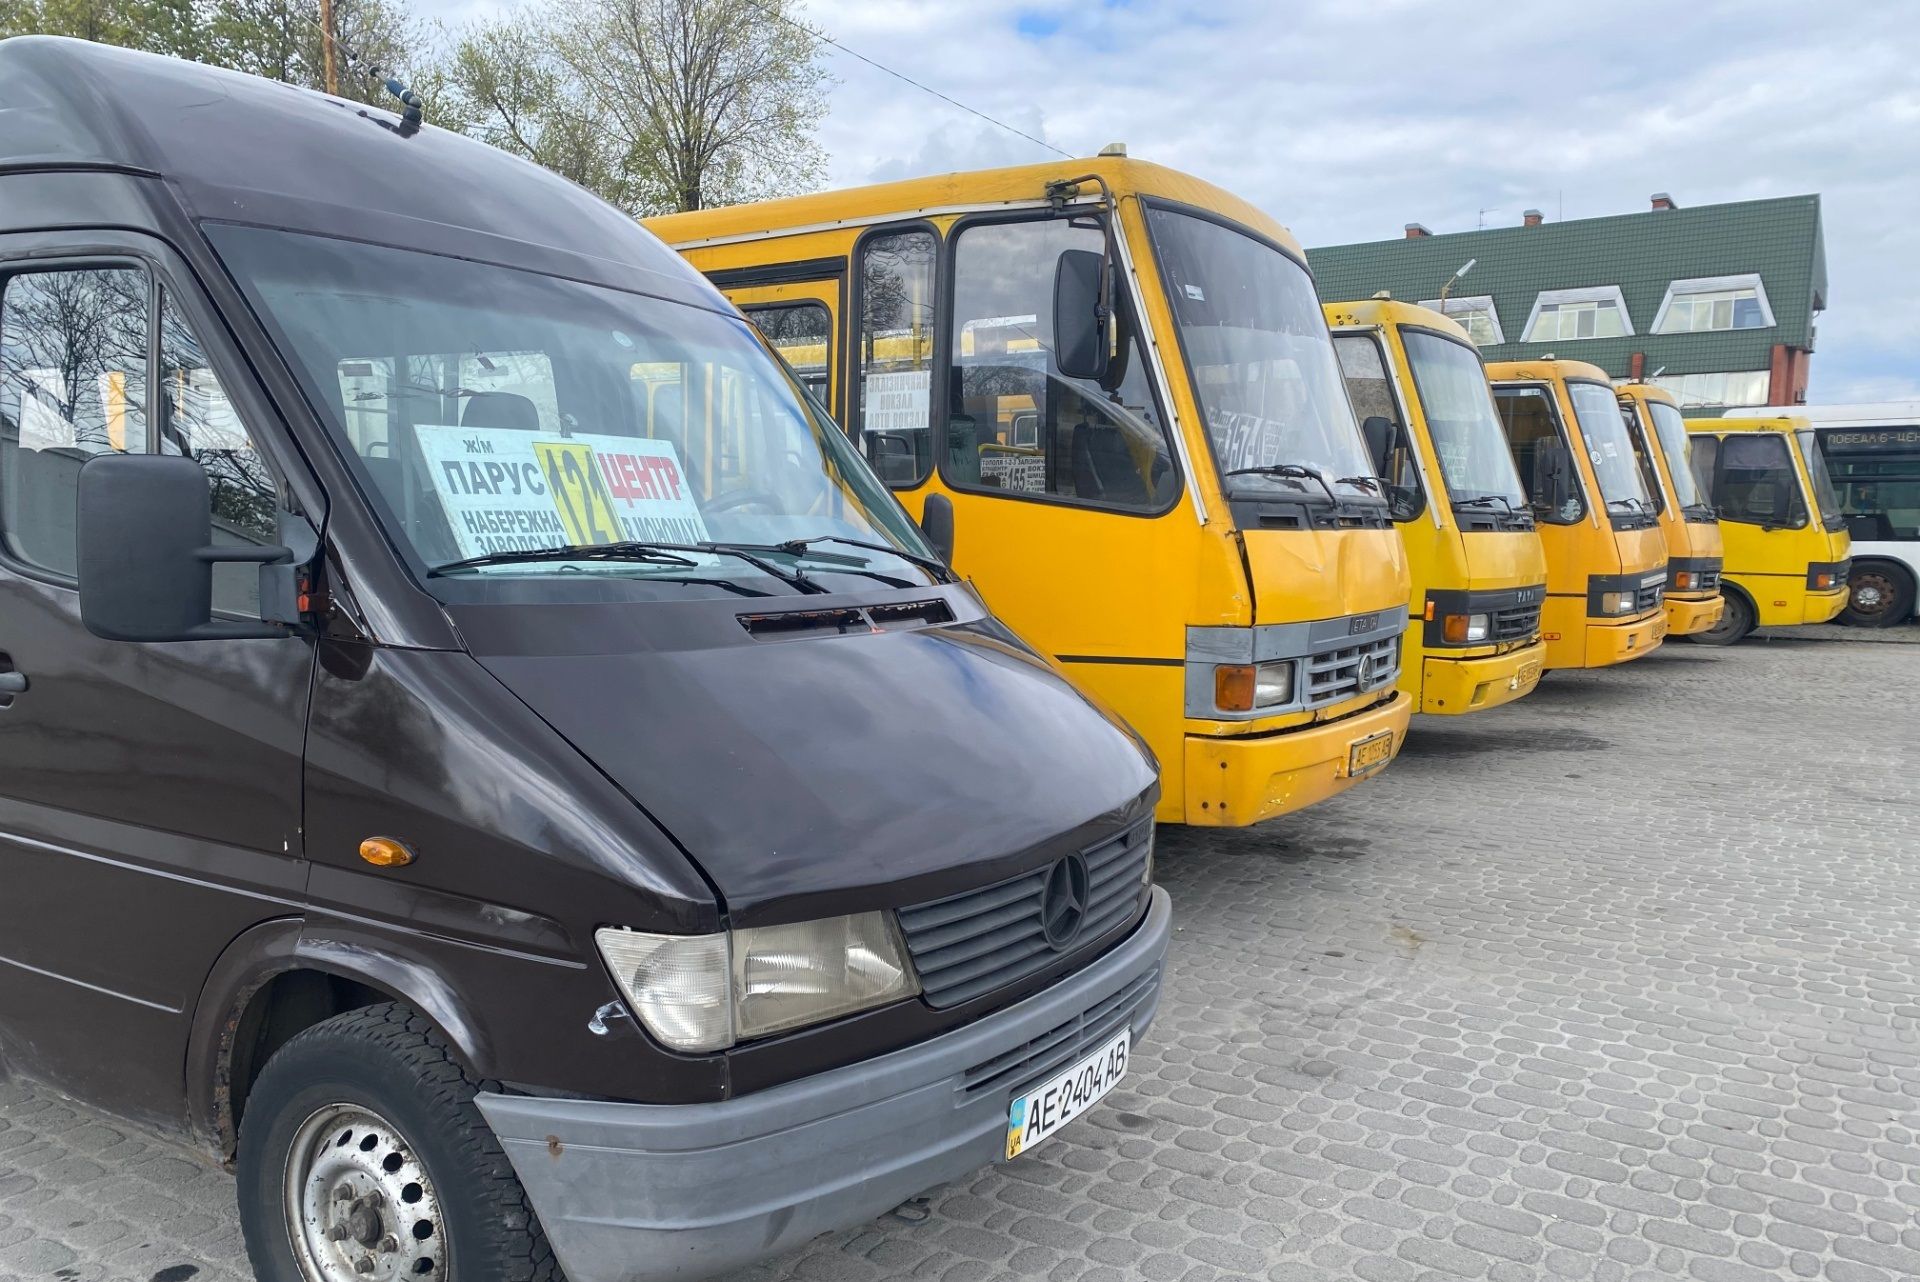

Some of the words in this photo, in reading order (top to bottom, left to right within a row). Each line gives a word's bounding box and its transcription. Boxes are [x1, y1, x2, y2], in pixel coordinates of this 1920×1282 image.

[440, 460, 545, 496] ПАРУС
[598, 453, 682, 508] ЦЕНТР
[1008, 467, 1026, 491] 155
[461, 510, 566, 534] НАБЕРЕЖНА
